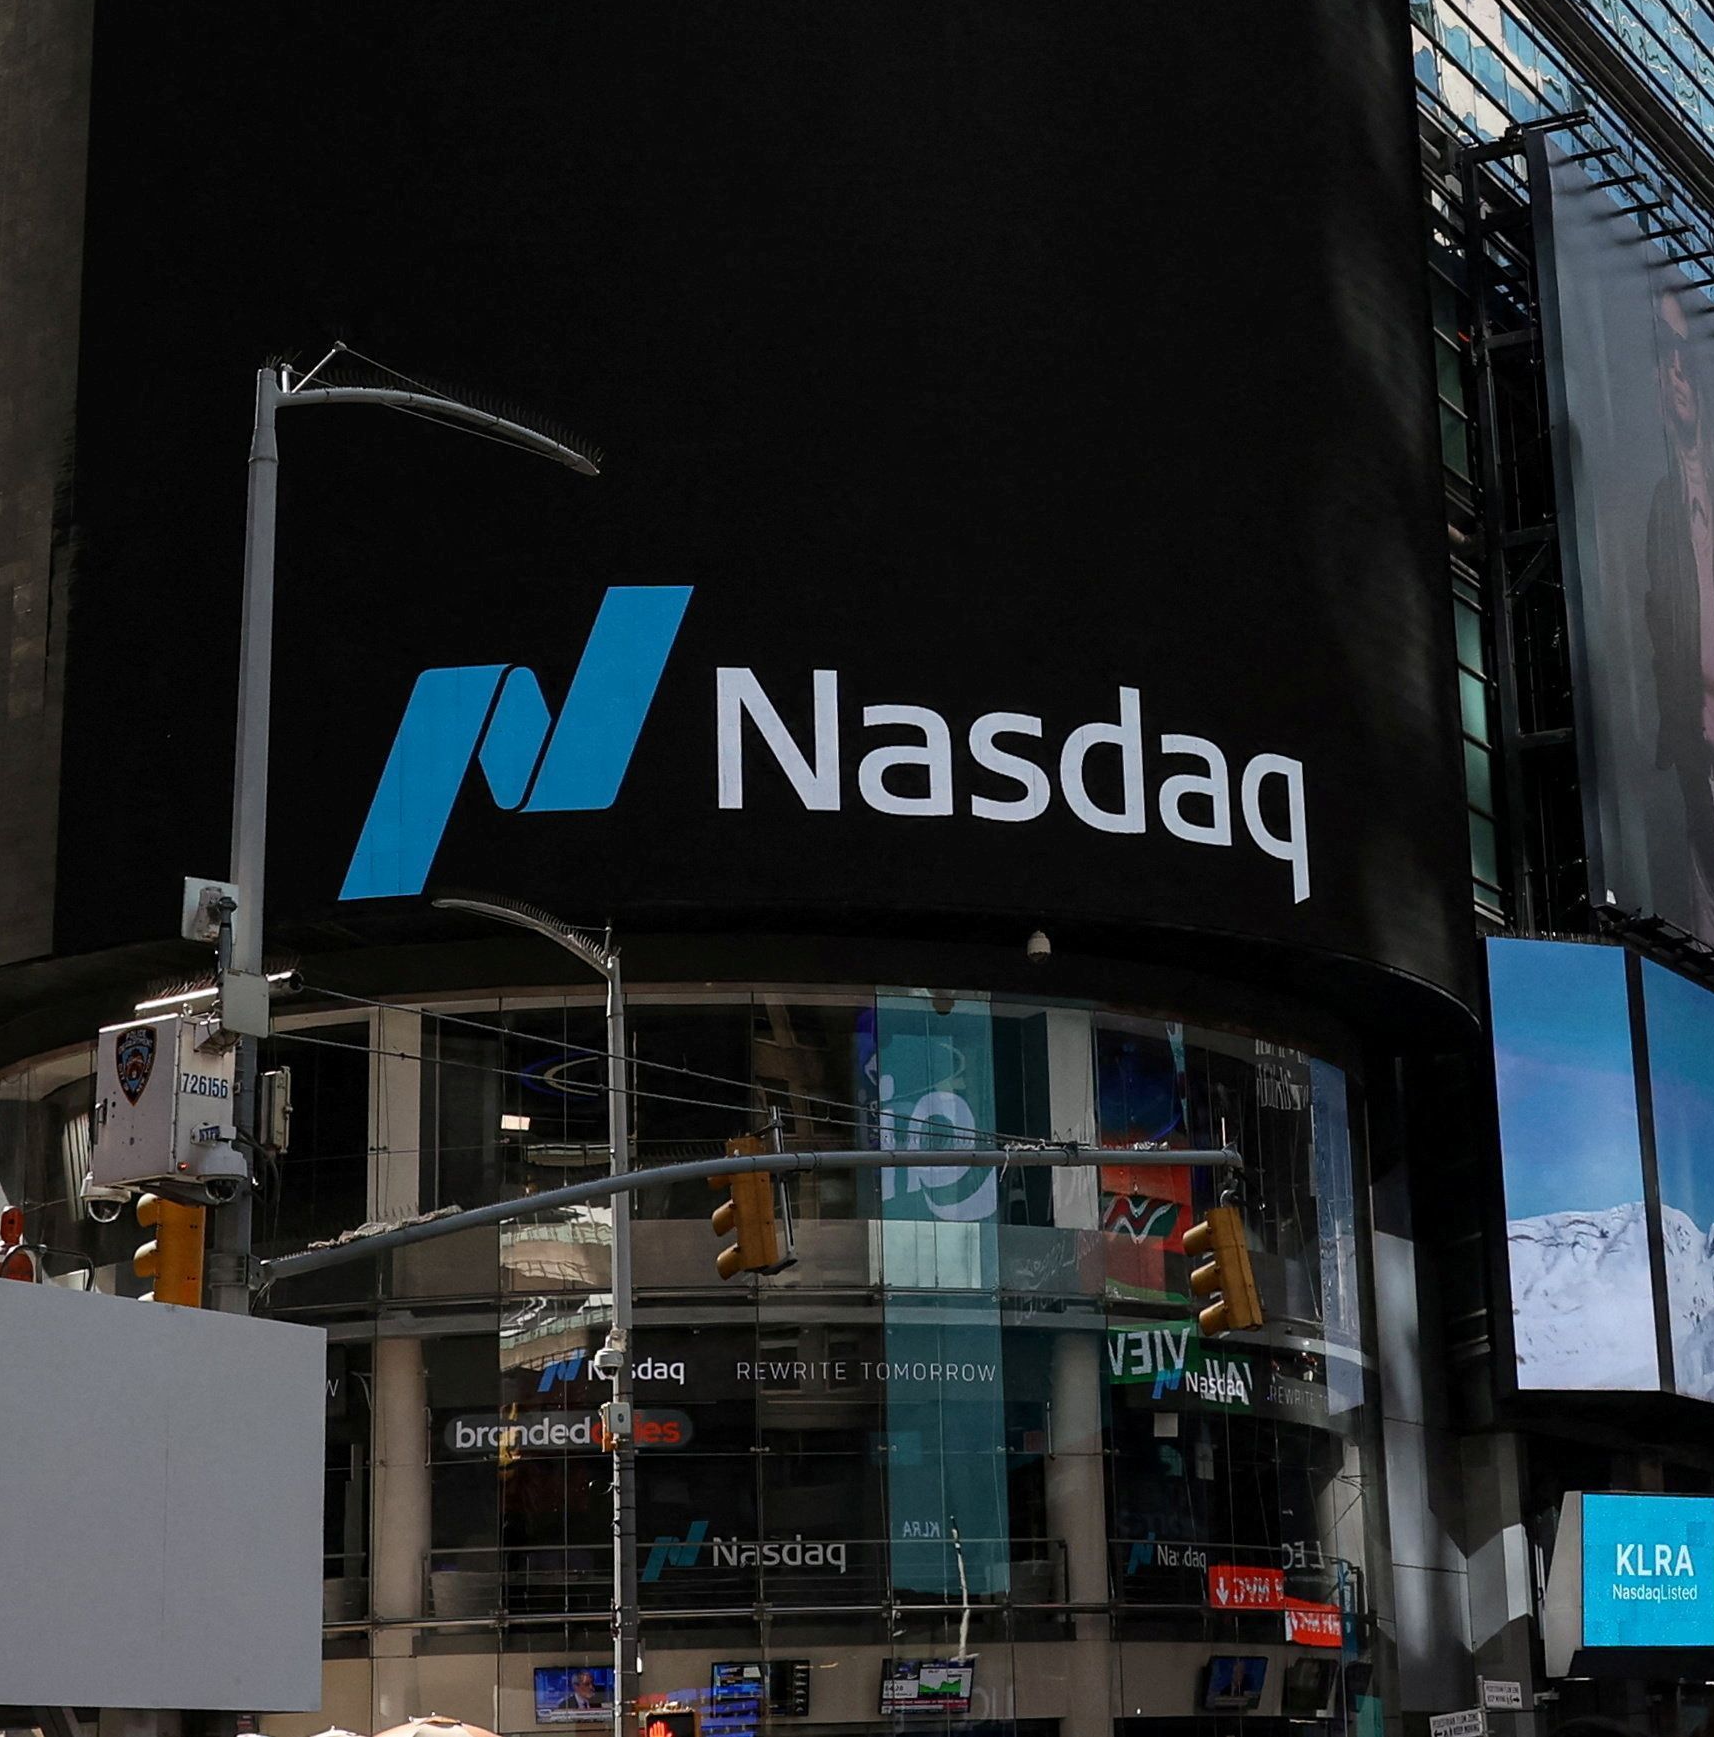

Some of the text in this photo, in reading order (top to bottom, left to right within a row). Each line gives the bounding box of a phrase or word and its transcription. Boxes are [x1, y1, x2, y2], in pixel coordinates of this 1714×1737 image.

[717, 666, 1310, 904] Nasdaq
[736, 1362, 996, 1382] REWRITE TOMORROW
[1186, 1371, 1245, 1398] Nasdaq
[713, 1534, 847, 1574] Nasdaq
[1615, 1543, 1696, 1577] KLRA
